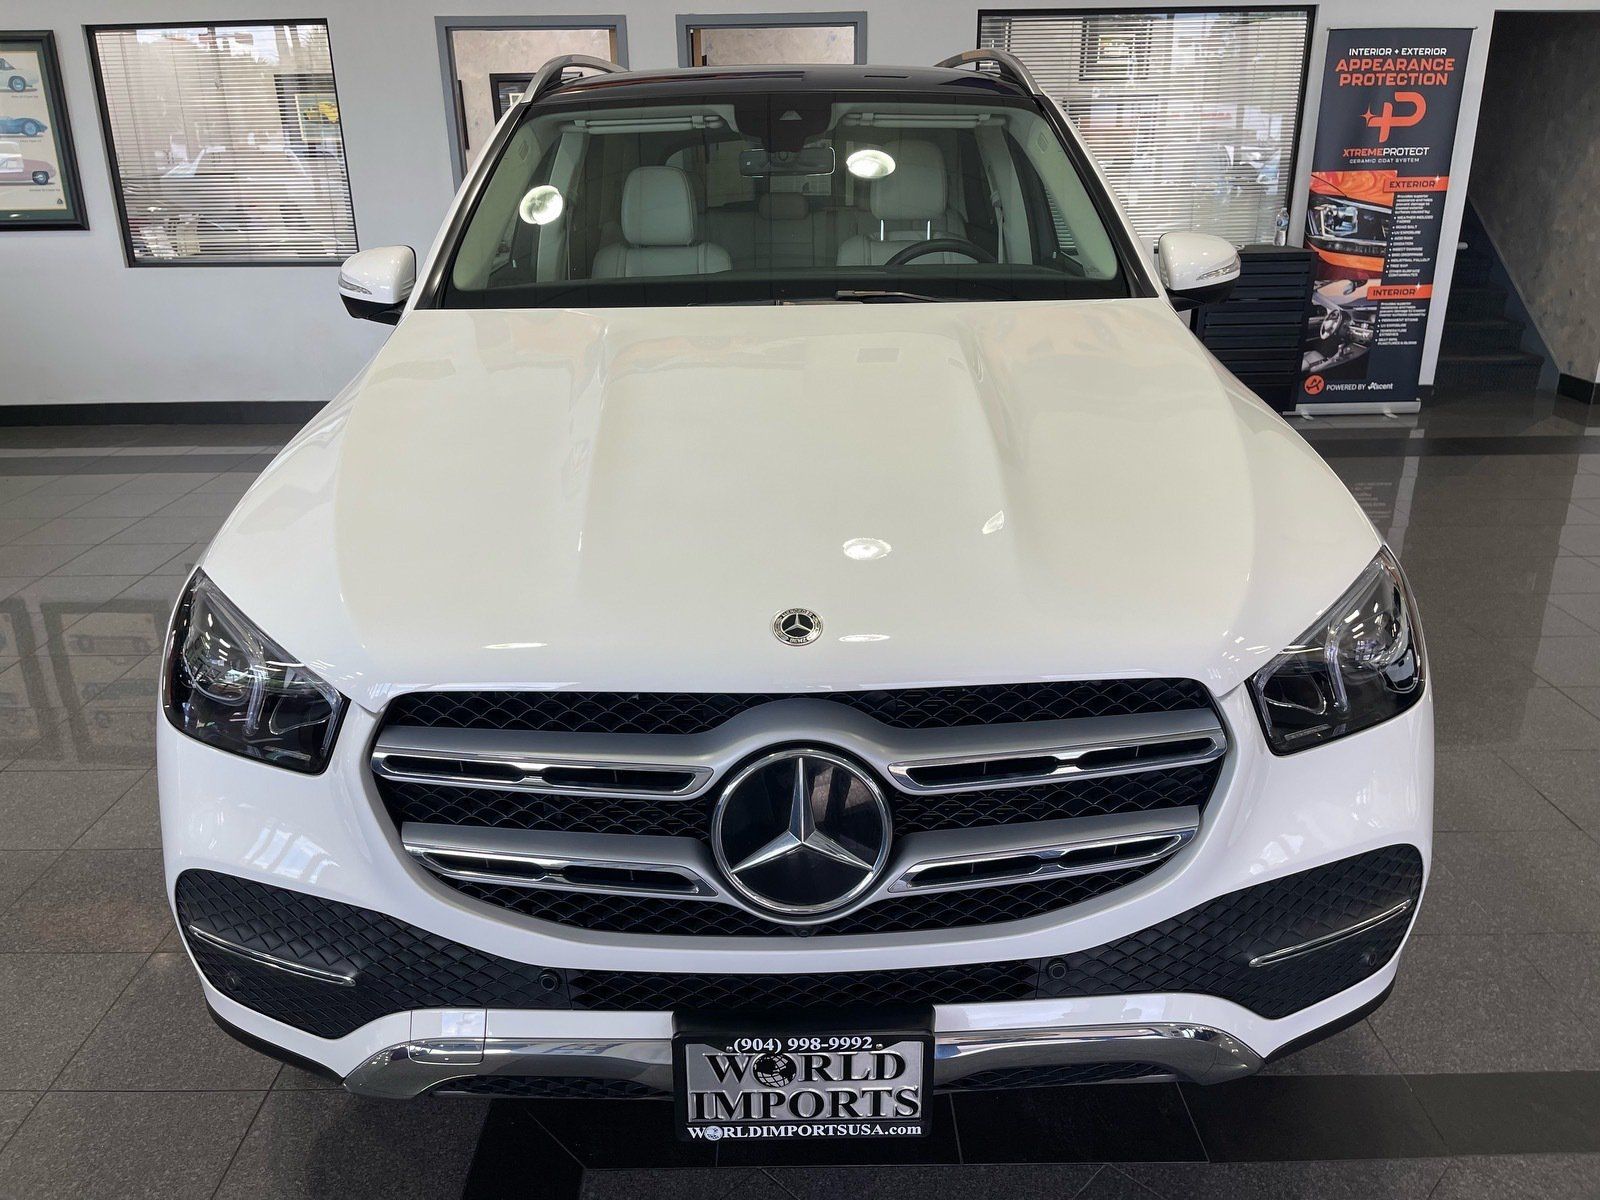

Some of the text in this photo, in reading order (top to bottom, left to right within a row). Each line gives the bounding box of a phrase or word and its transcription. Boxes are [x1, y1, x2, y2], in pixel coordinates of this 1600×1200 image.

[1349, 48, 1392, 56] INTERIOR
[1401, 47, 1447, 56] EXTERIOR
[1335, 58, 1455, 72] APPEARANCE
[1339, 73, 1448, 86] PROTECTION
[1343, 147, 1429, 157] XTREMEPROTECT
[1390, 180, 1436, 188] EXTERIOR
[1373, 288, 1416, 296] INTERIOR
[1326, 383, 1357, 391] POWERED
[733, 1036, 873, 1054] (904) 998-9992
[689, 1086, 921, 1121] IMPORTS
